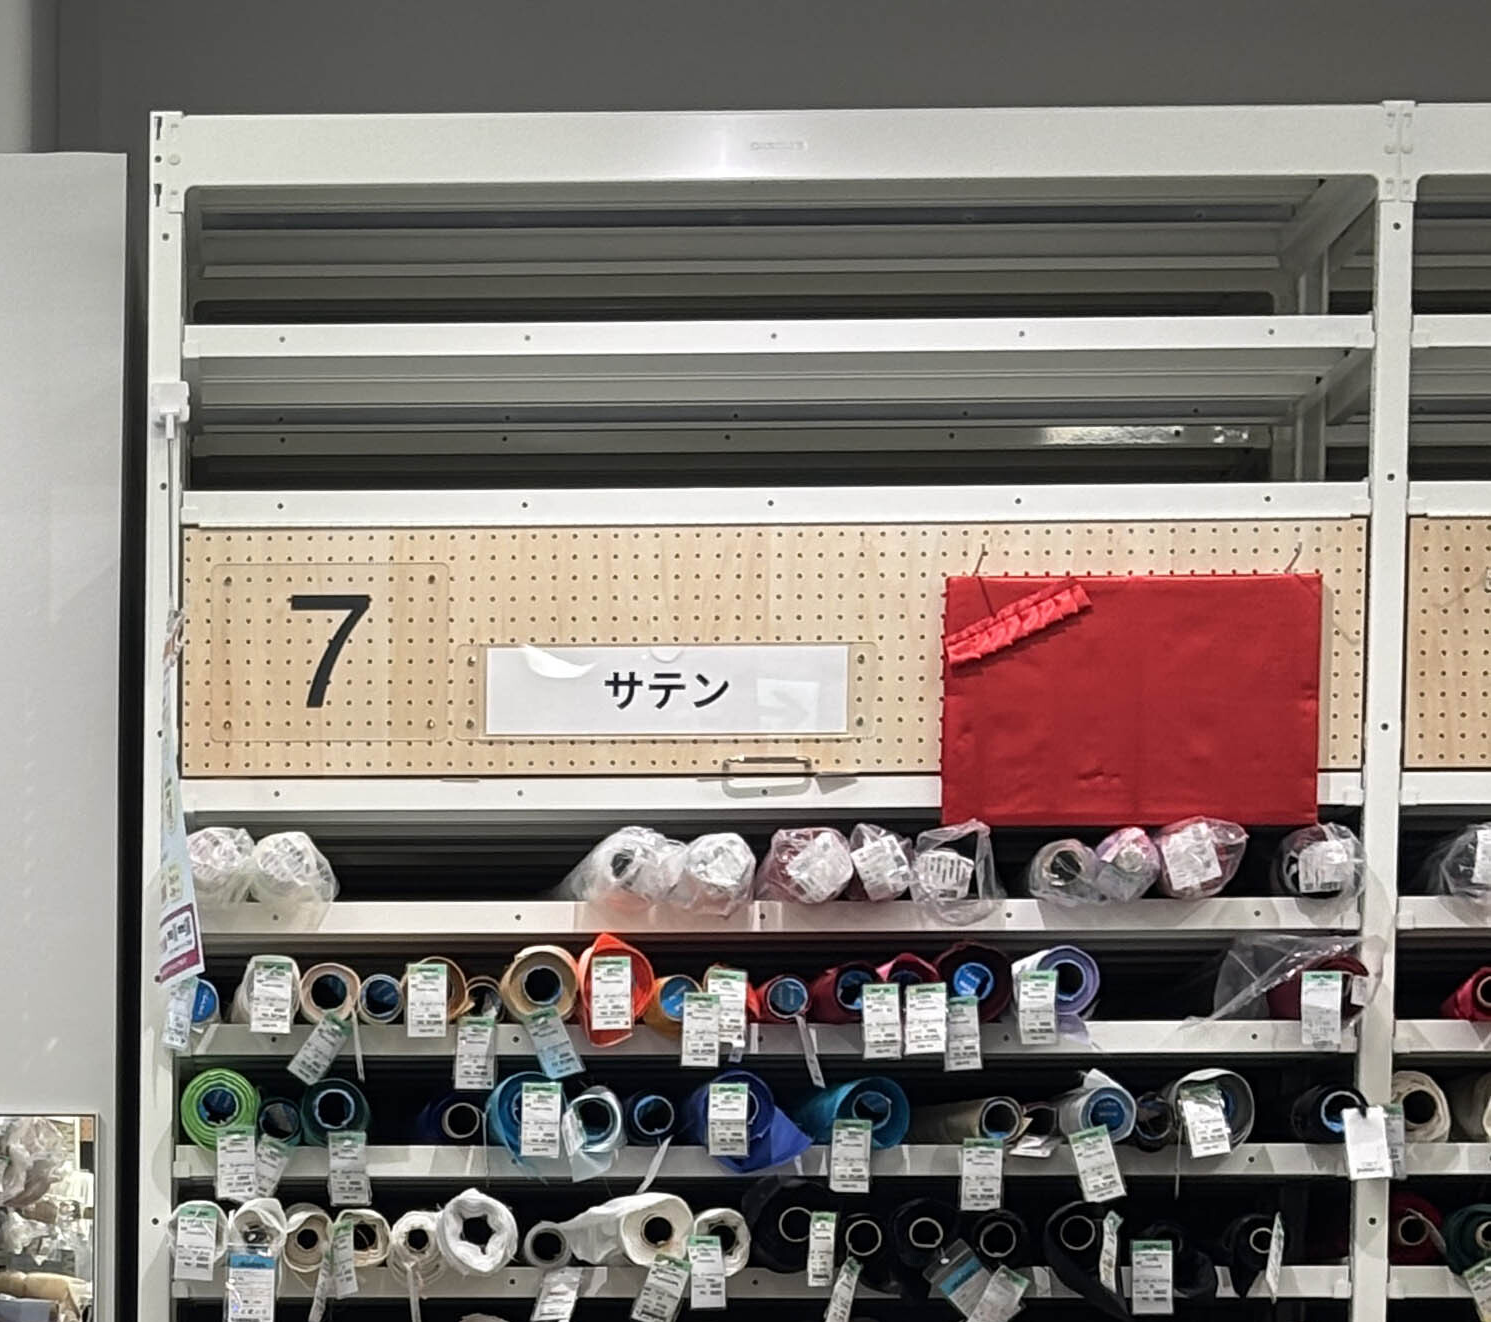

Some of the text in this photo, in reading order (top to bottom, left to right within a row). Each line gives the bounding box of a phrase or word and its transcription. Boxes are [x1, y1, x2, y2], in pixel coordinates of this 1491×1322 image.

[291, 595, 370, 707] 7
[605, 672, 728, 708] サテン
